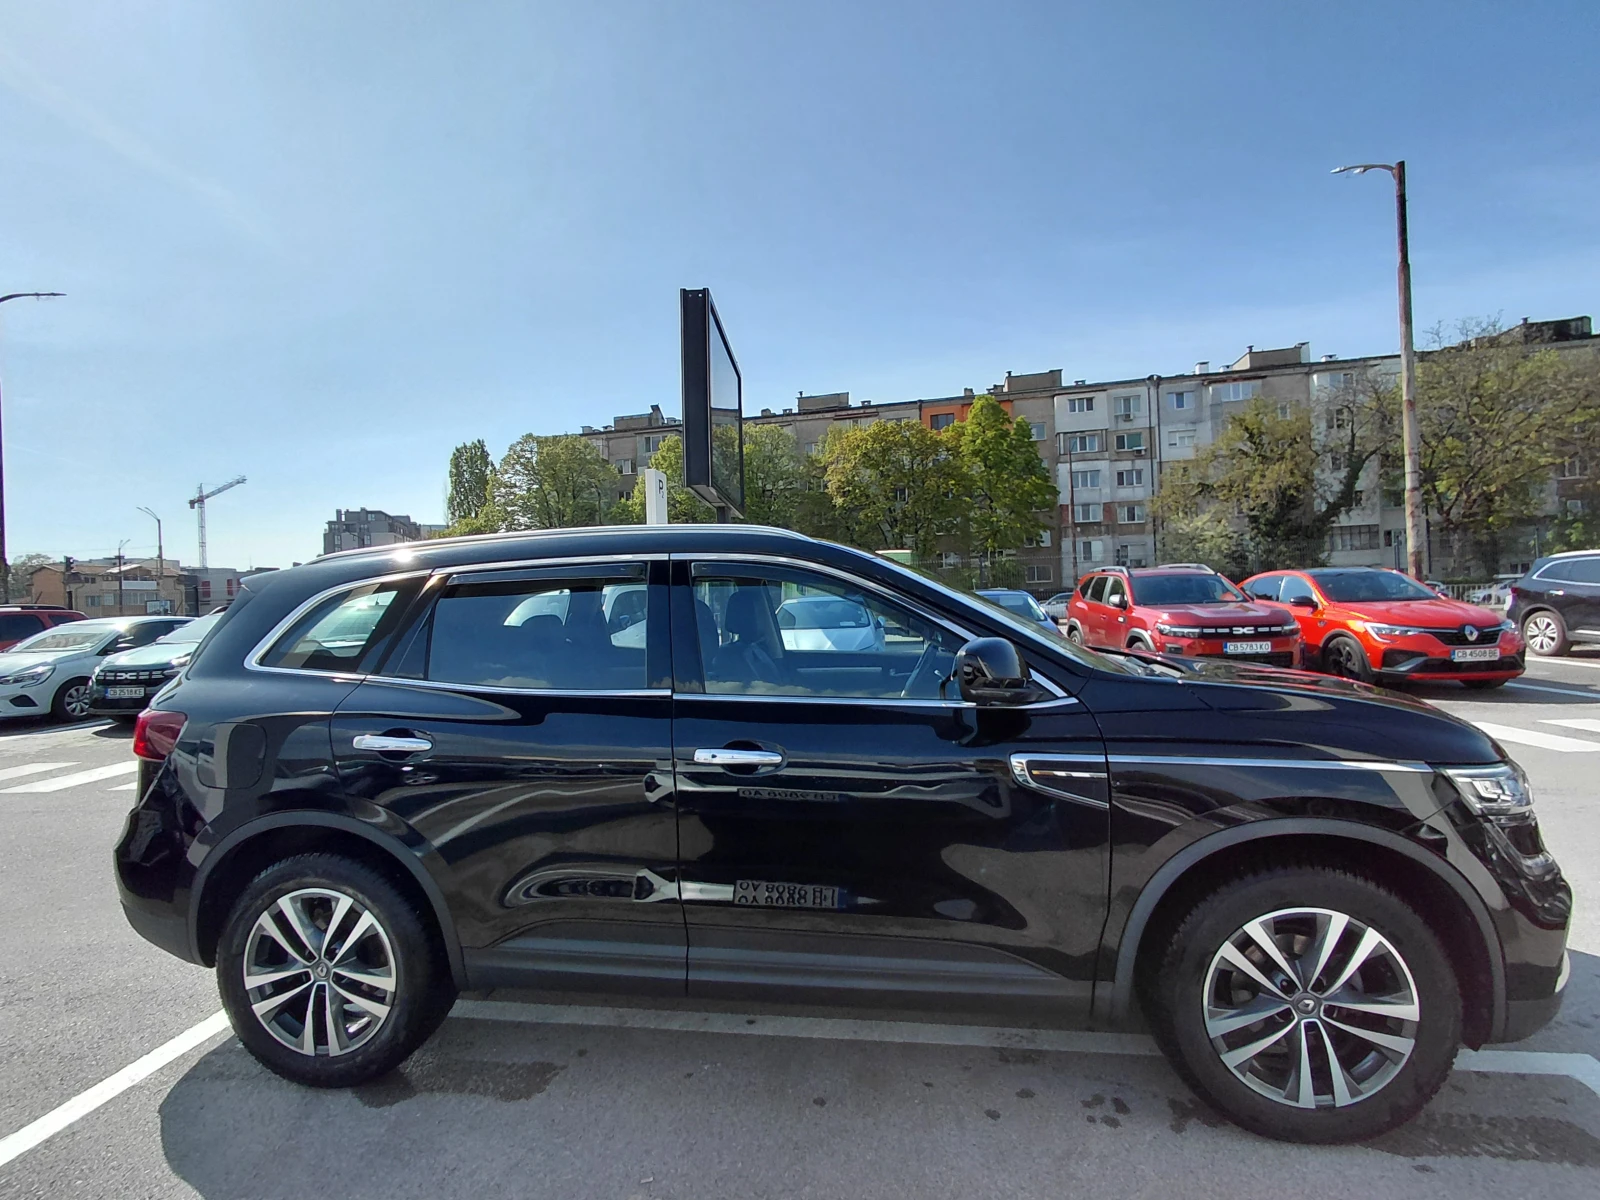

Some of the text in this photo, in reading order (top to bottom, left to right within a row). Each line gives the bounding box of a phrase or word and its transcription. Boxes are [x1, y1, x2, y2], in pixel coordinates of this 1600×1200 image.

[1228, 643, 1238, 651] CB
[1240, 643, 1259, 651] 5783
[1456, 650, 1467, 658] CB
[1468, 650, 1487, 658] 4508
